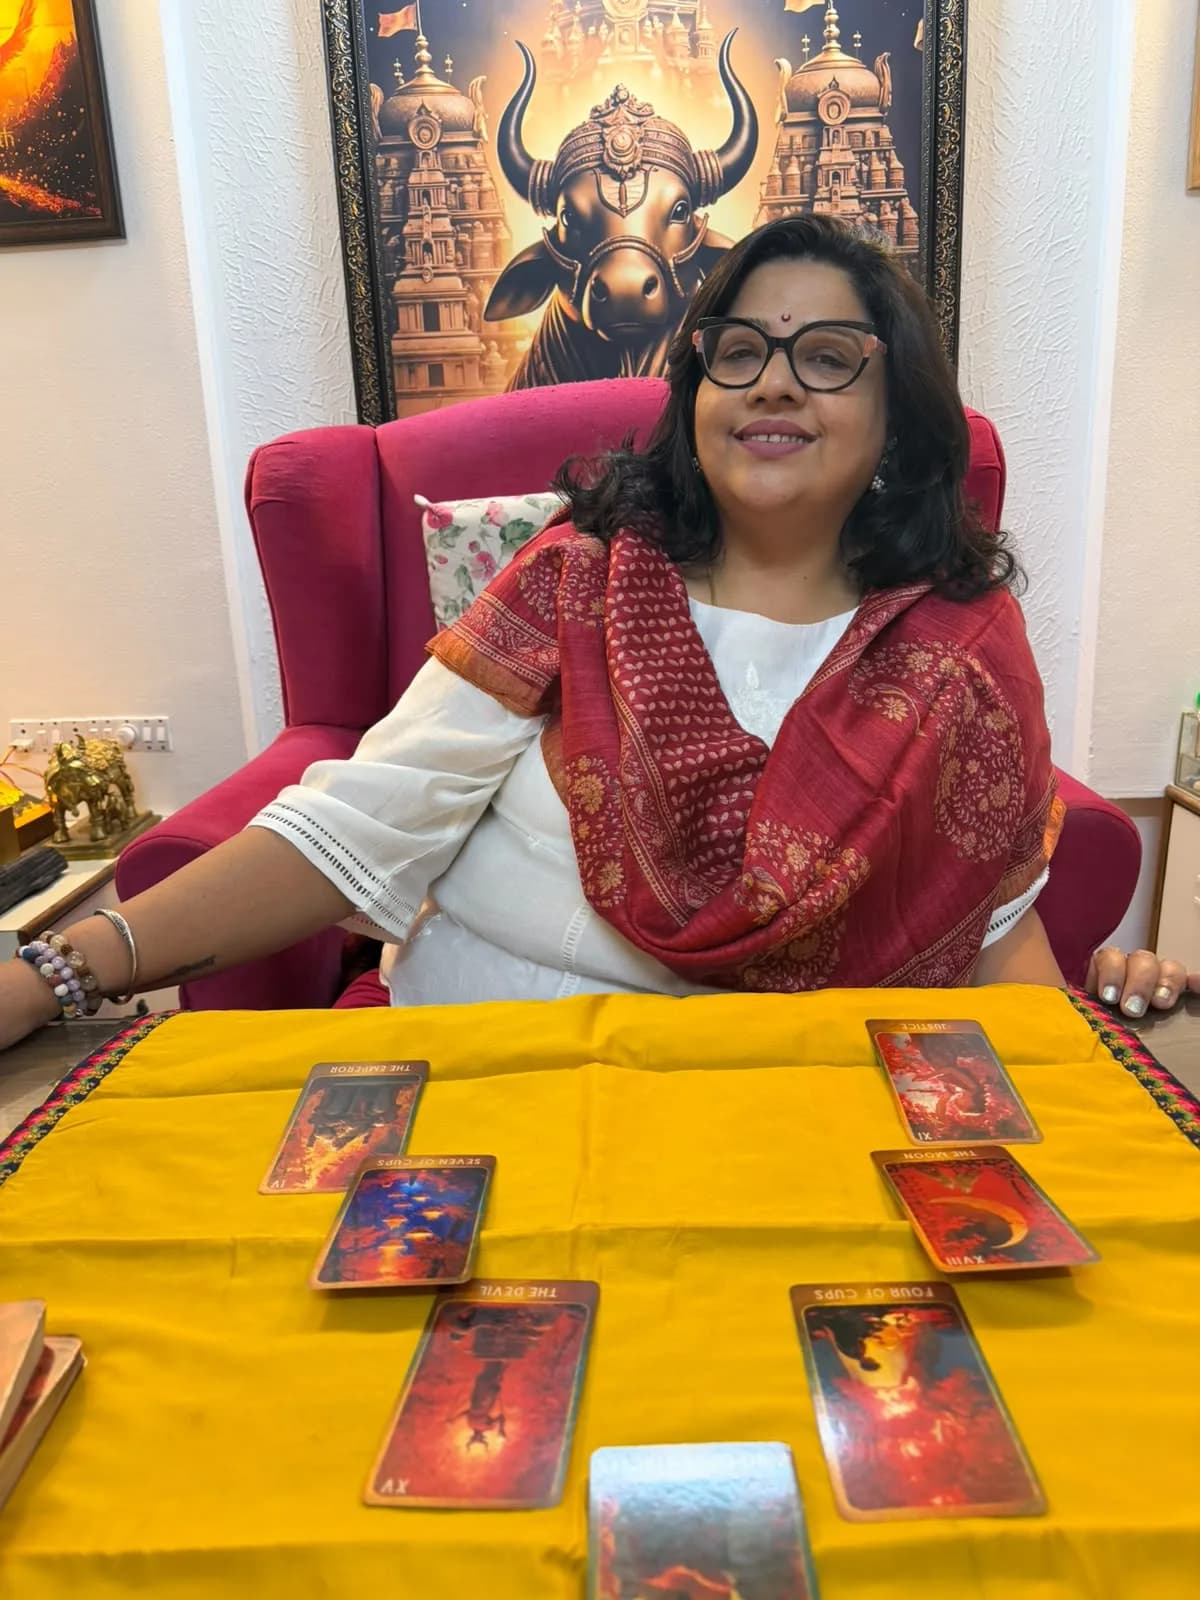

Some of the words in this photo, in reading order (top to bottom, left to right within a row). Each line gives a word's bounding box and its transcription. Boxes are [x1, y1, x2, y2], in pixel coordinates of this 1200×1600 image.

[330, 1064, 387, 1073] EMPEROR
[389, 1064, 412, 1072] THE
[918, 1132, 933, 1140] XI
[903, 1151, 945, 1159] MOON
[953, 1149, 977, 1157] THE
[376, 1159, 412, 1167] CUPS
[438, 1158, 481, 1166] SEVEN
[946, 1255, 986, 1265] XVIII
[480, 1285, 524, 1297] DEVIL
[528, 1286, 558, 1298] THE
[814, 1288, 857, 1300] CUPS
[864, 1288, 885, 1298] OF
[890, 1287, 935, 1298] FOUR
[380, 1477, 410, 1494] XV
